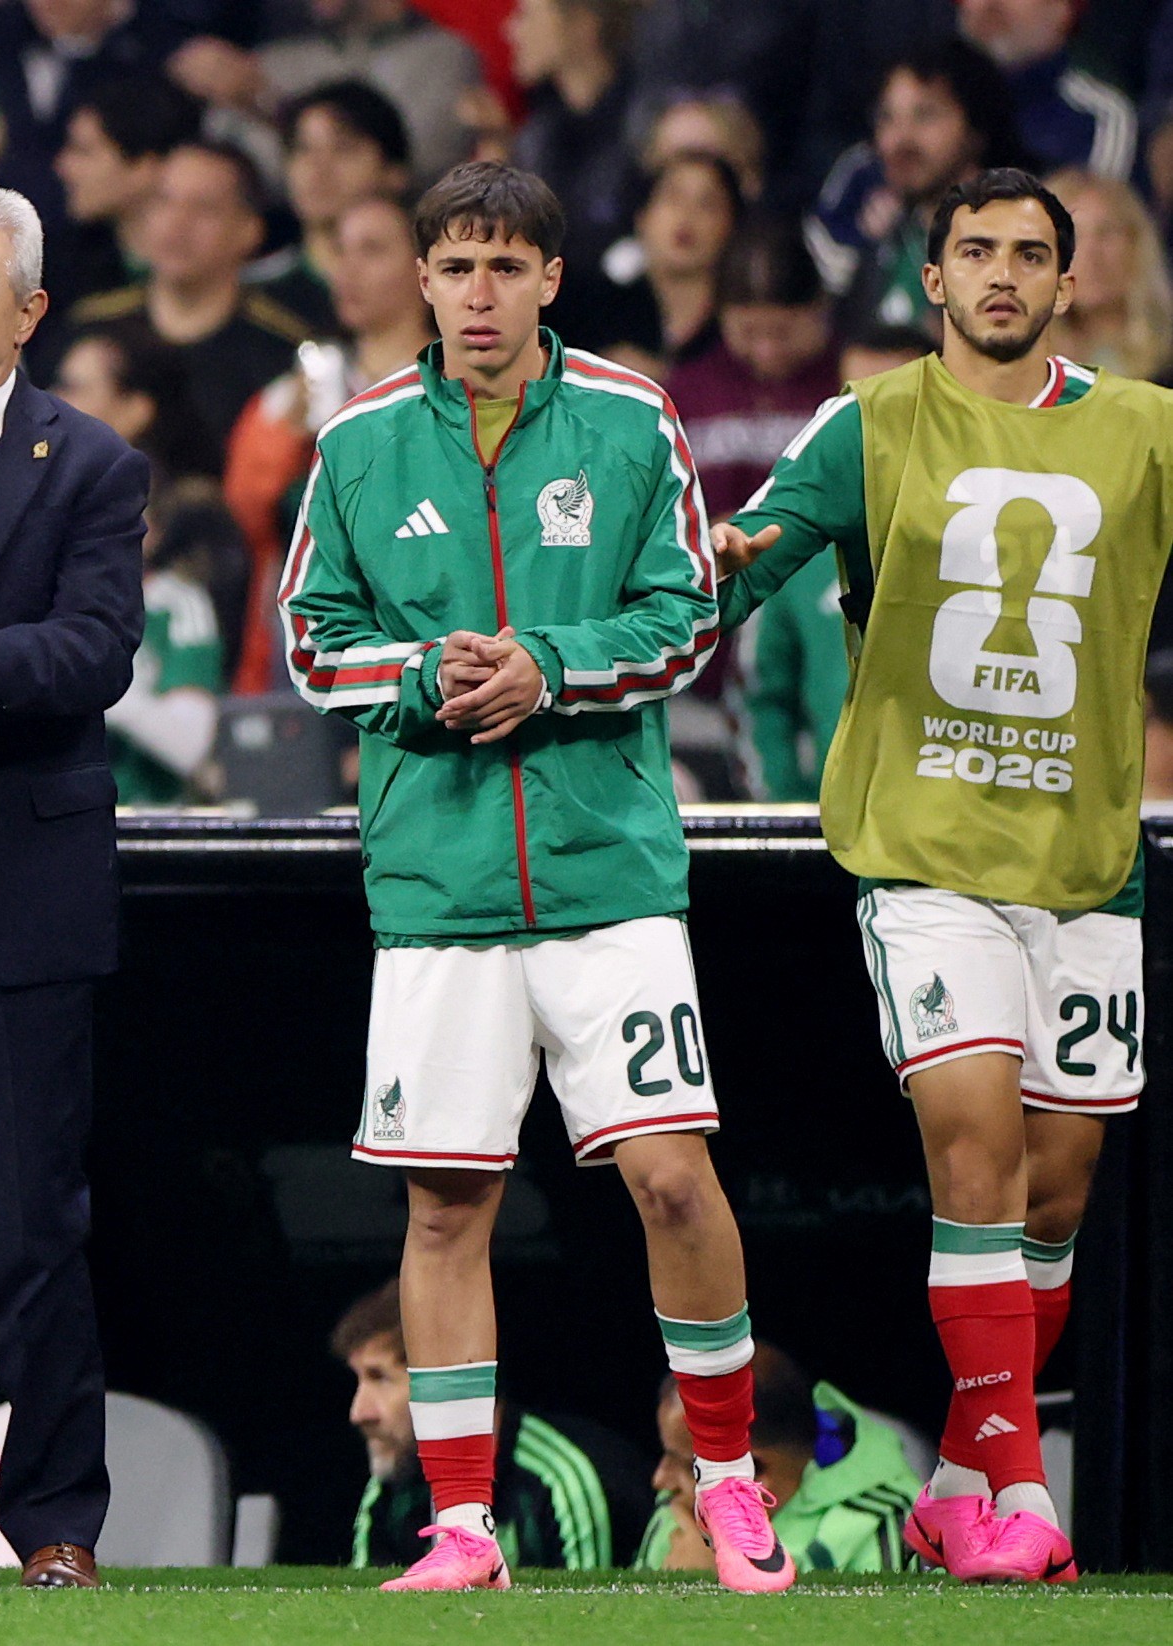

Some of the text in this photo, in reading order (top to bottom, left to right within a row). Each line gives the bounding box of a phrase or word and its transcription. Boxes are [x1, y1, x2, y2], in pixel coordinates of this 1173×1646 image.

[541, 532, 589, 544] MÉXICO
[973, 664, 1041, 695] FIFA
[923, 715, 1077, 754] WORLD CUP
[916, 743, 1073, 793] 2026
[622, 1003, 705, 1097] 20
[1056, 990, 1139, 1077] 24
